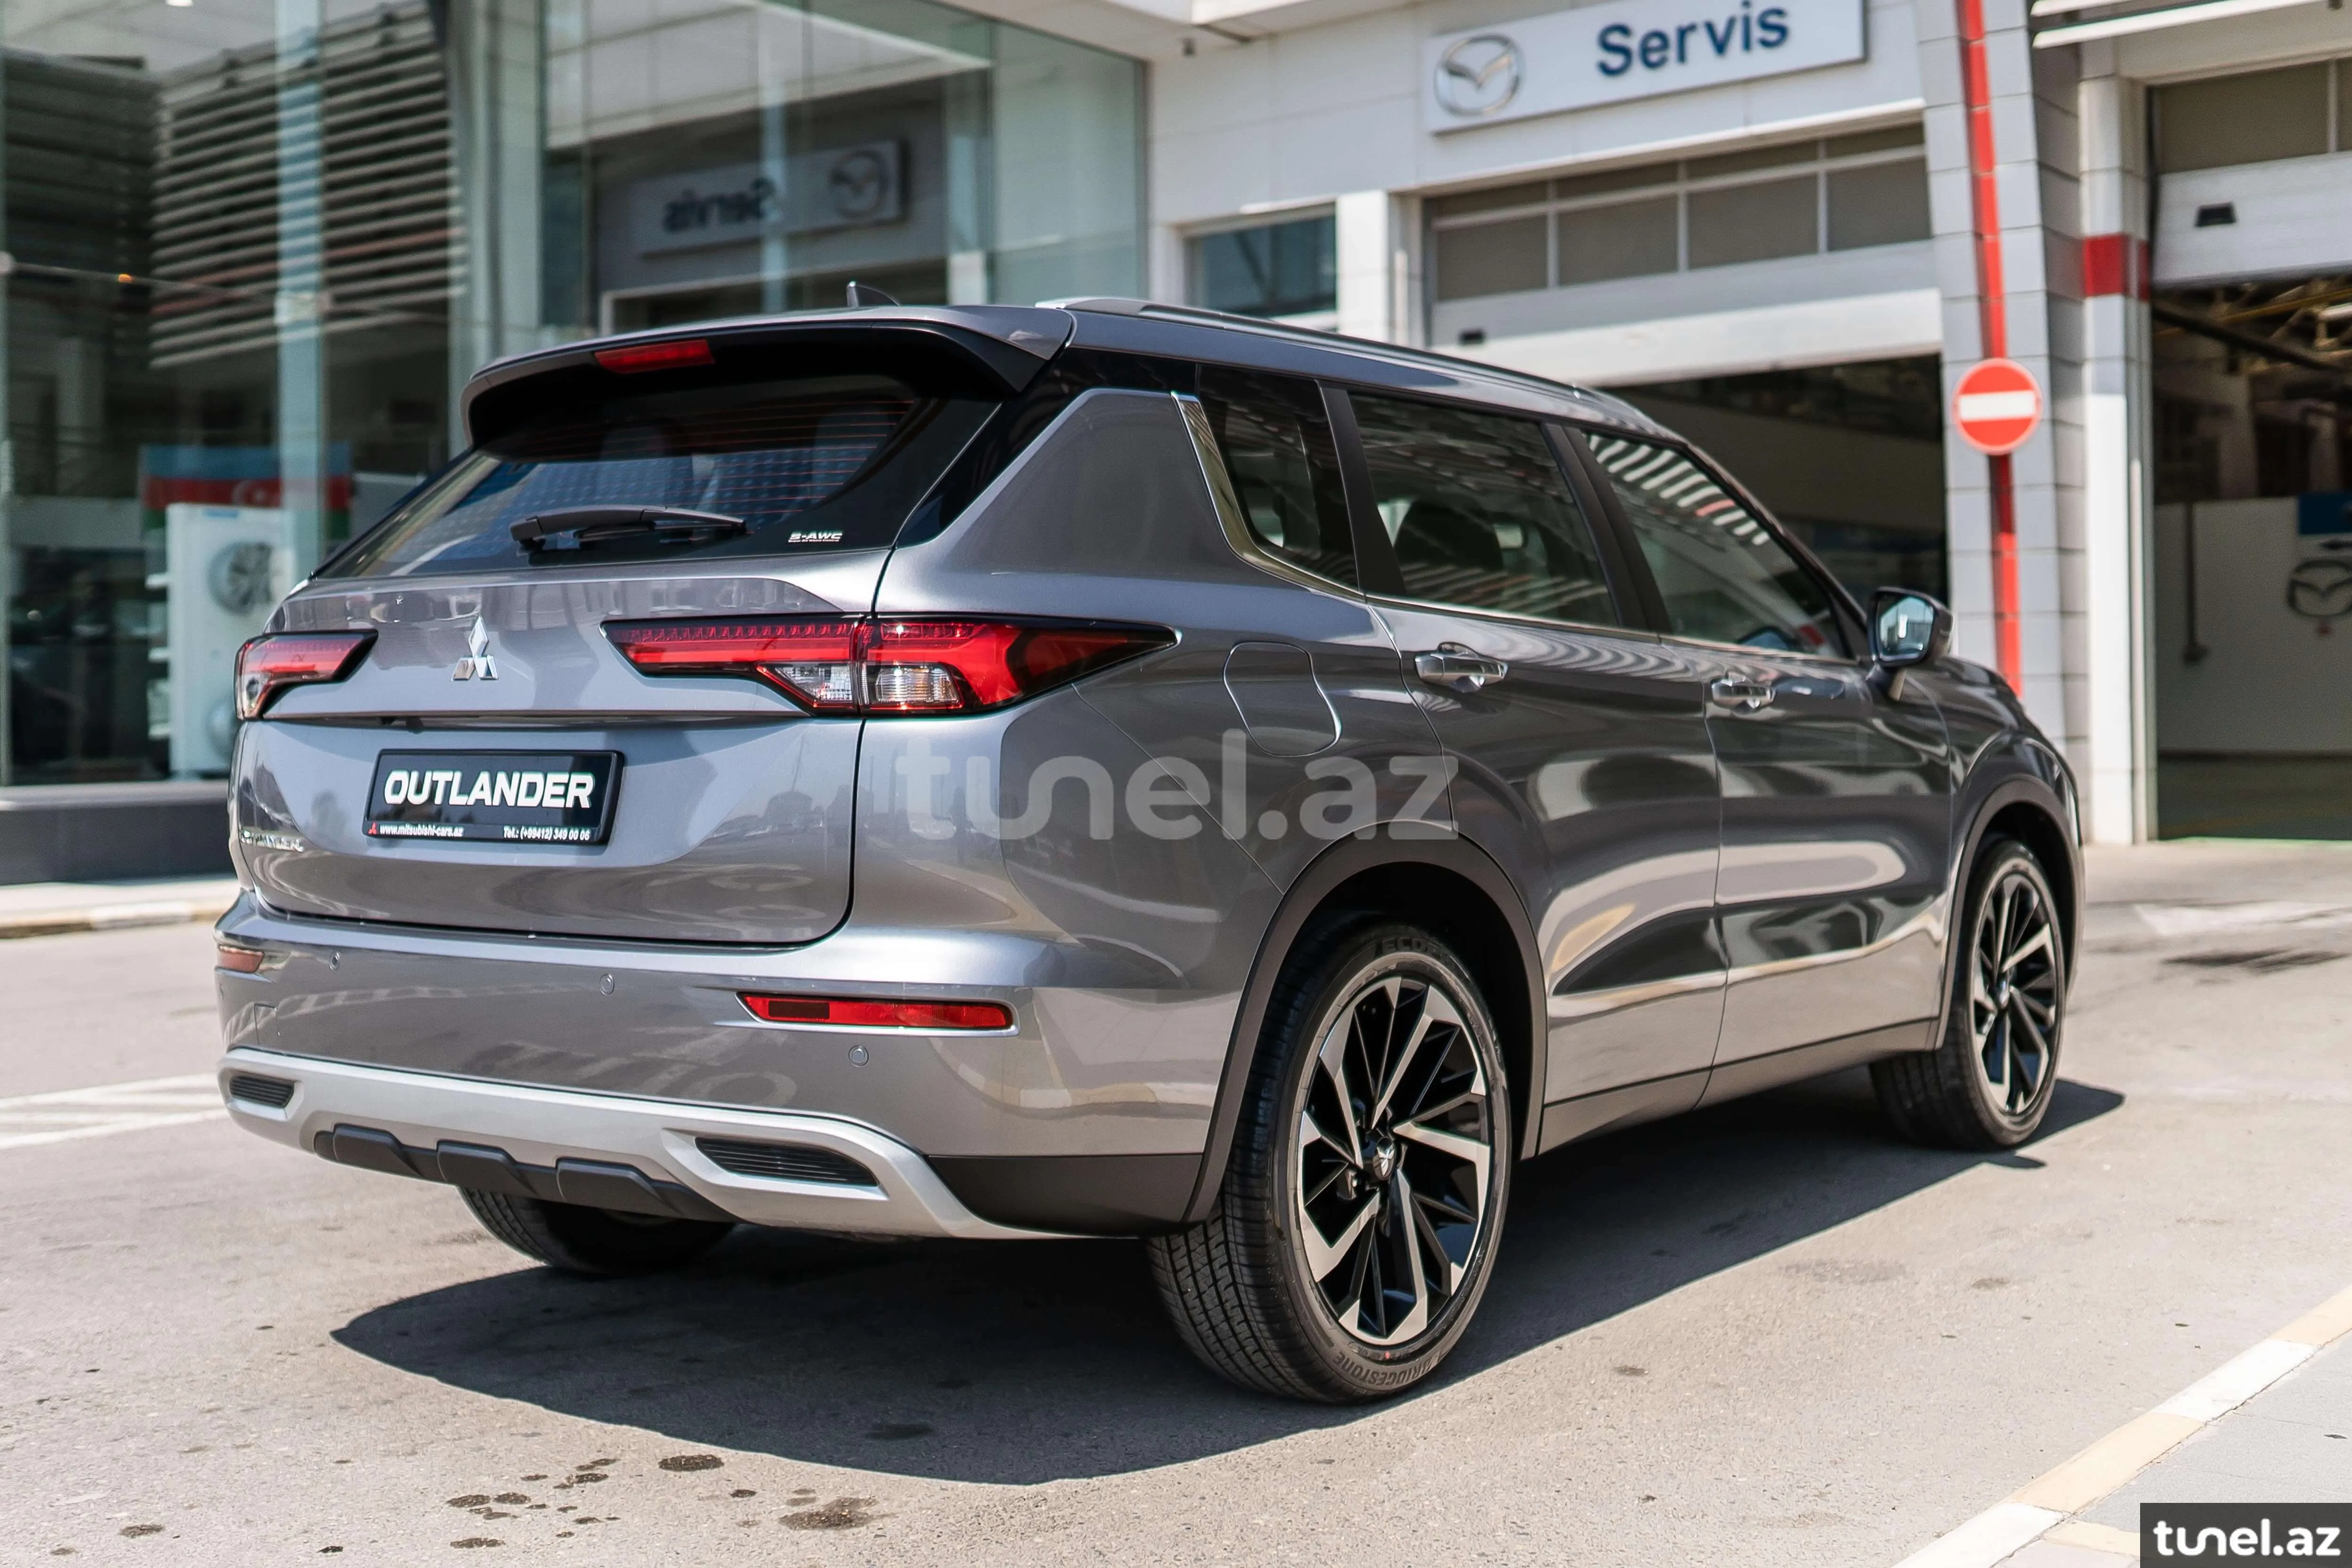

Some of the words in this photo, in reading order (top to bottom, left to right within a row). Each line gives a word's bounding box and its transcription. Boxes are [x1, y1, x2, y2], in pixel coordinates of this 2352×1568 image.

[1597, 0, 1789, 76] Servis
[789, 531, 843, 540] S-AWC
[384, 770, 595, 808] OUTLANDER
[379, 822, 464, 838] www.mitsubishi-cars.az
[520, 826, 553, 841] (+99412)
[553, 828, 567, 840] 349
[568, 829, 579, 840] 00
[580, 829, 590, 841] 06
